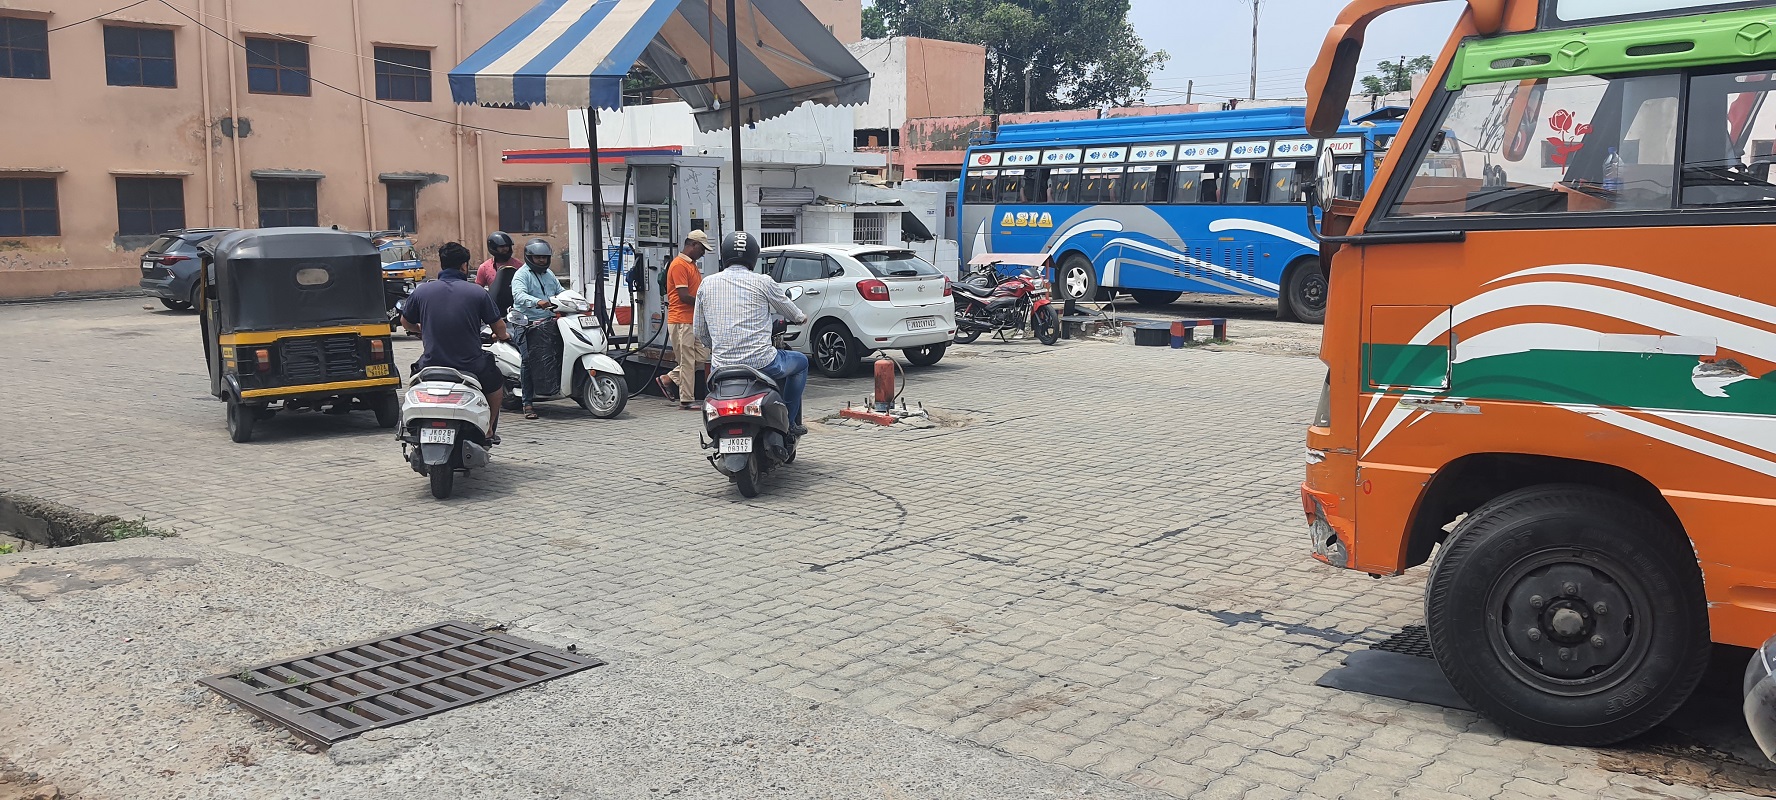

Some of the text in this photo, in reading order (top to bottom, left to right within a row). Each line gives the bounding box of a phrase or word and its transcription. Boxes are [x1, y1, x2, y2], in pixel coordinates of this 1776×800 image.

[1330, 142, 1353, 150] PILOT
[1001, 212, 1053, 227] ASIA
[727, 438, 748, 446] JK02C
[1605, 676, 1657, 715] MRF
